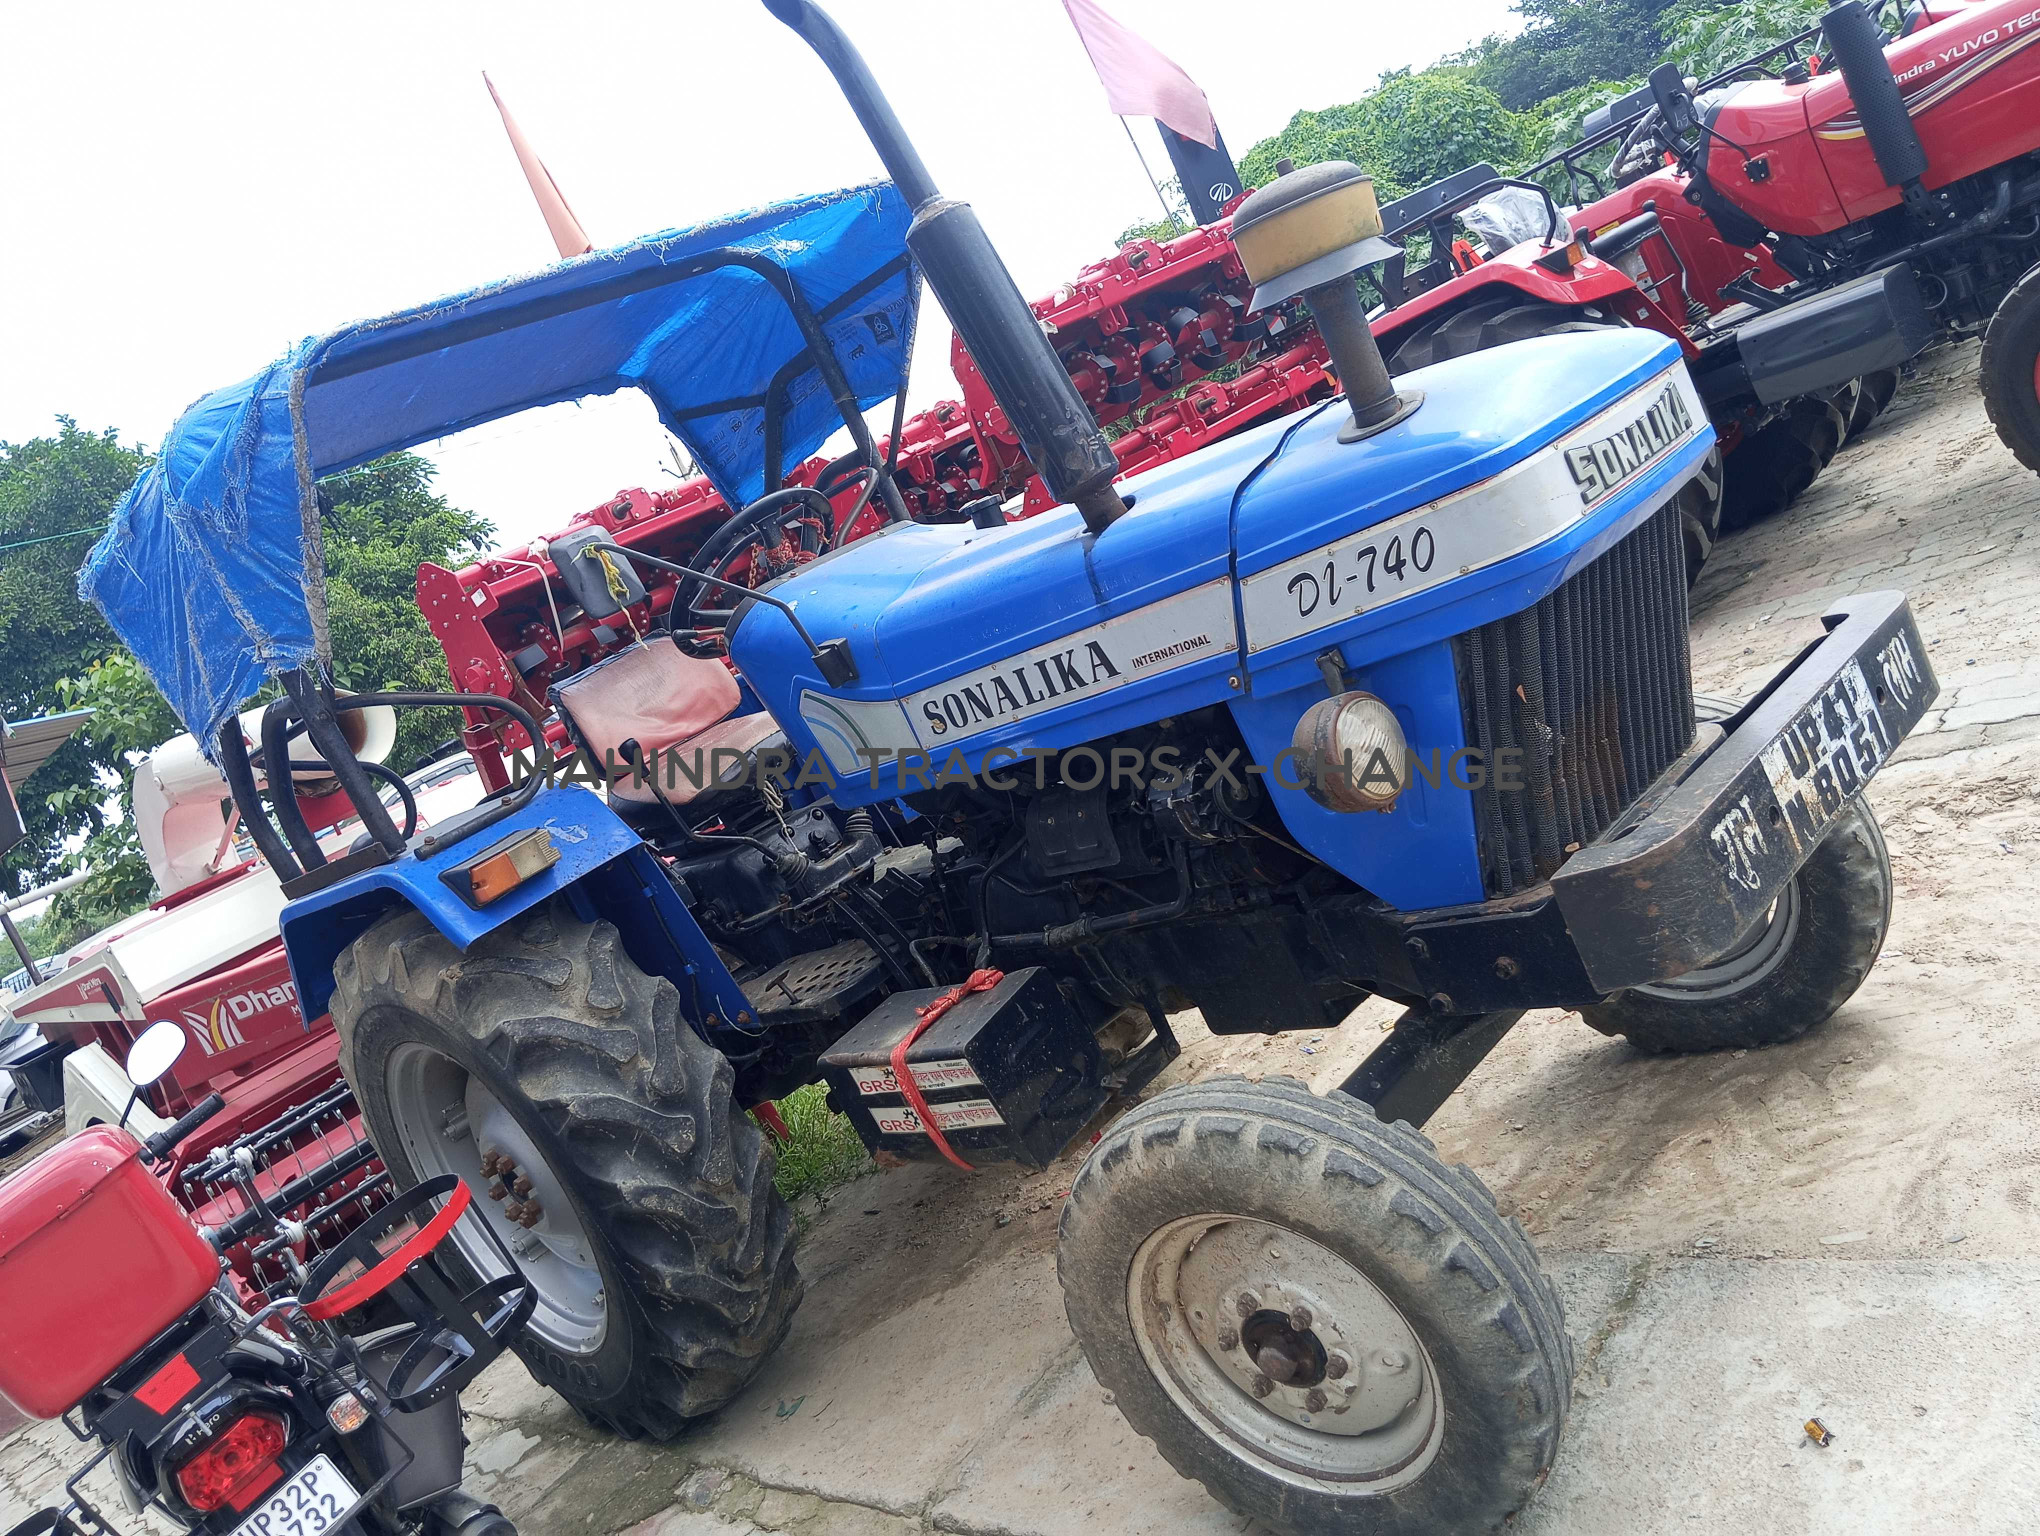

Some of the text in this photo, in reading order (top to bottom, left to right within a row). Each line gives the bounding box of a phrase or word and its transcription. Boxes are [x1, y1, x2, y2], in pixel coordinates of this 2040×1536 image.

[1939, 28, 1999, 62] YUVO
[1564, 381, 1693, 505] SONALIKA
[1288, 526, 1435, 617] DI-740
[922, 634, 1211, 735] SONALIKA INTERNATIONAL
[859, 1079, 896, 1093] GRS
[880, 1119, 916, 1131] GRS
